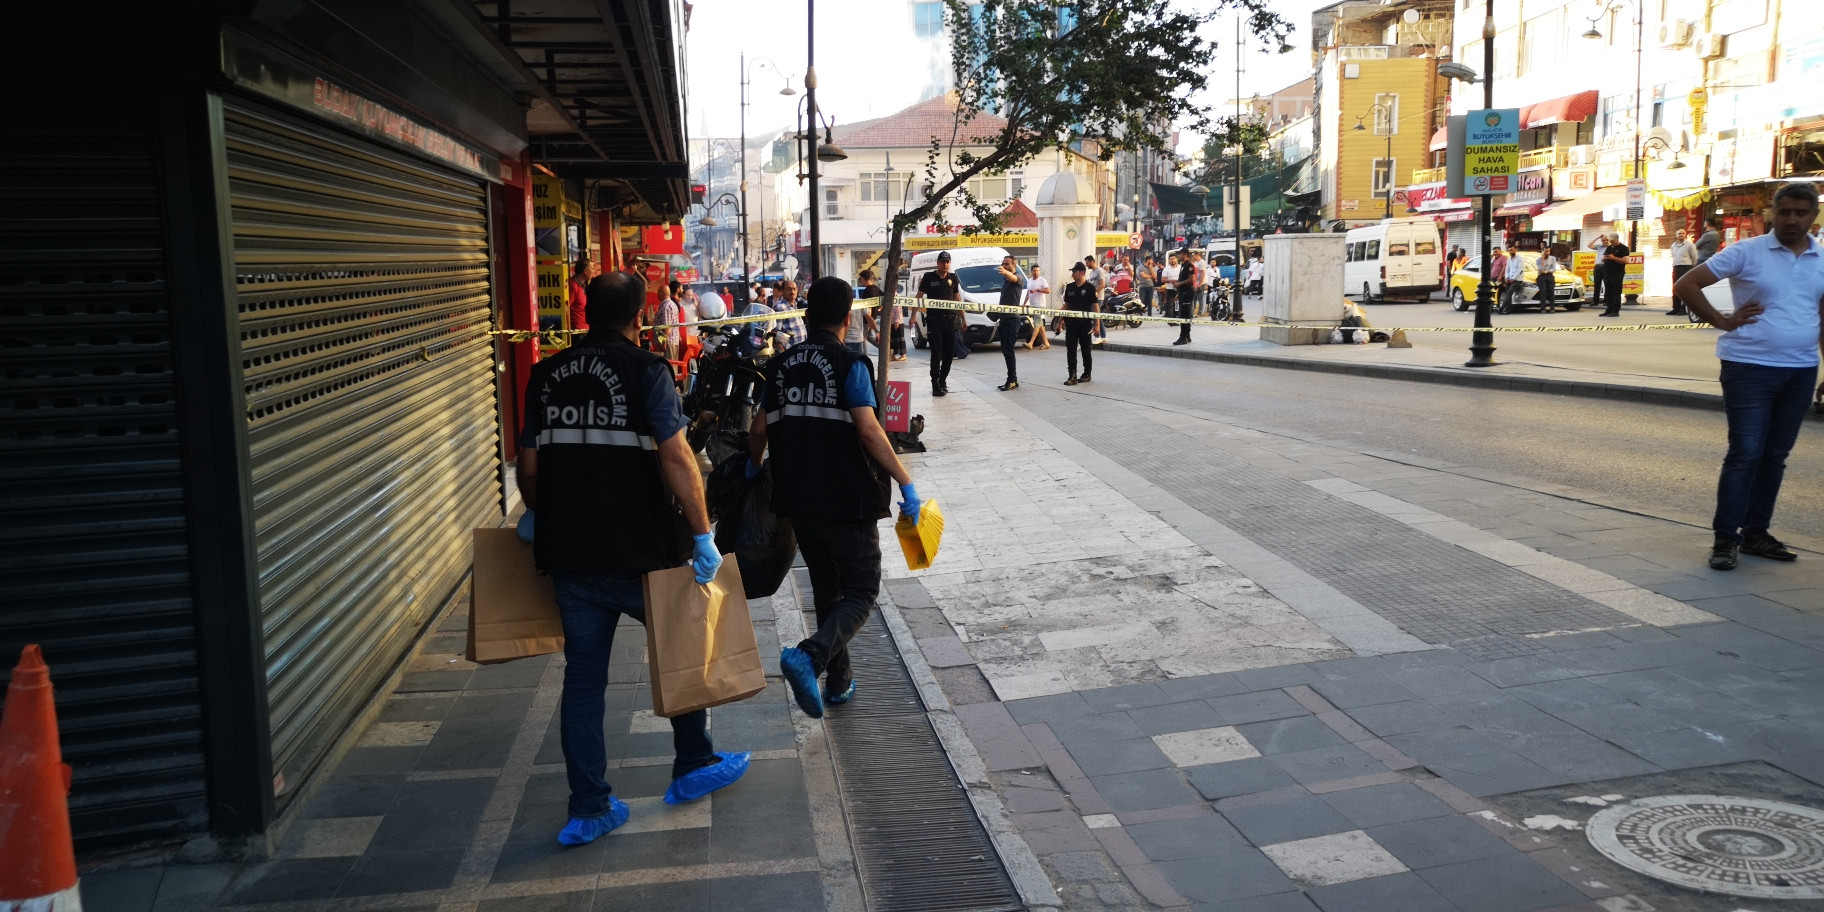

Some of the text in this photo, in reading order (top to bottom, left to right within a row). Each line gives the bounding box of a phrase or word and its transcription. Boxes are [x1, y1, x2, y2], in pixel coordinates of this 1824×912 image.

[1466, 145, 1518, 155] DUMANSIZ
[1479, 156, 1505, 164] HAVA
[1472, 166, 1510, 175] SAHASI
[1573, 174, 1586, 187] E
[785, 382, 823, 404] OLİS
